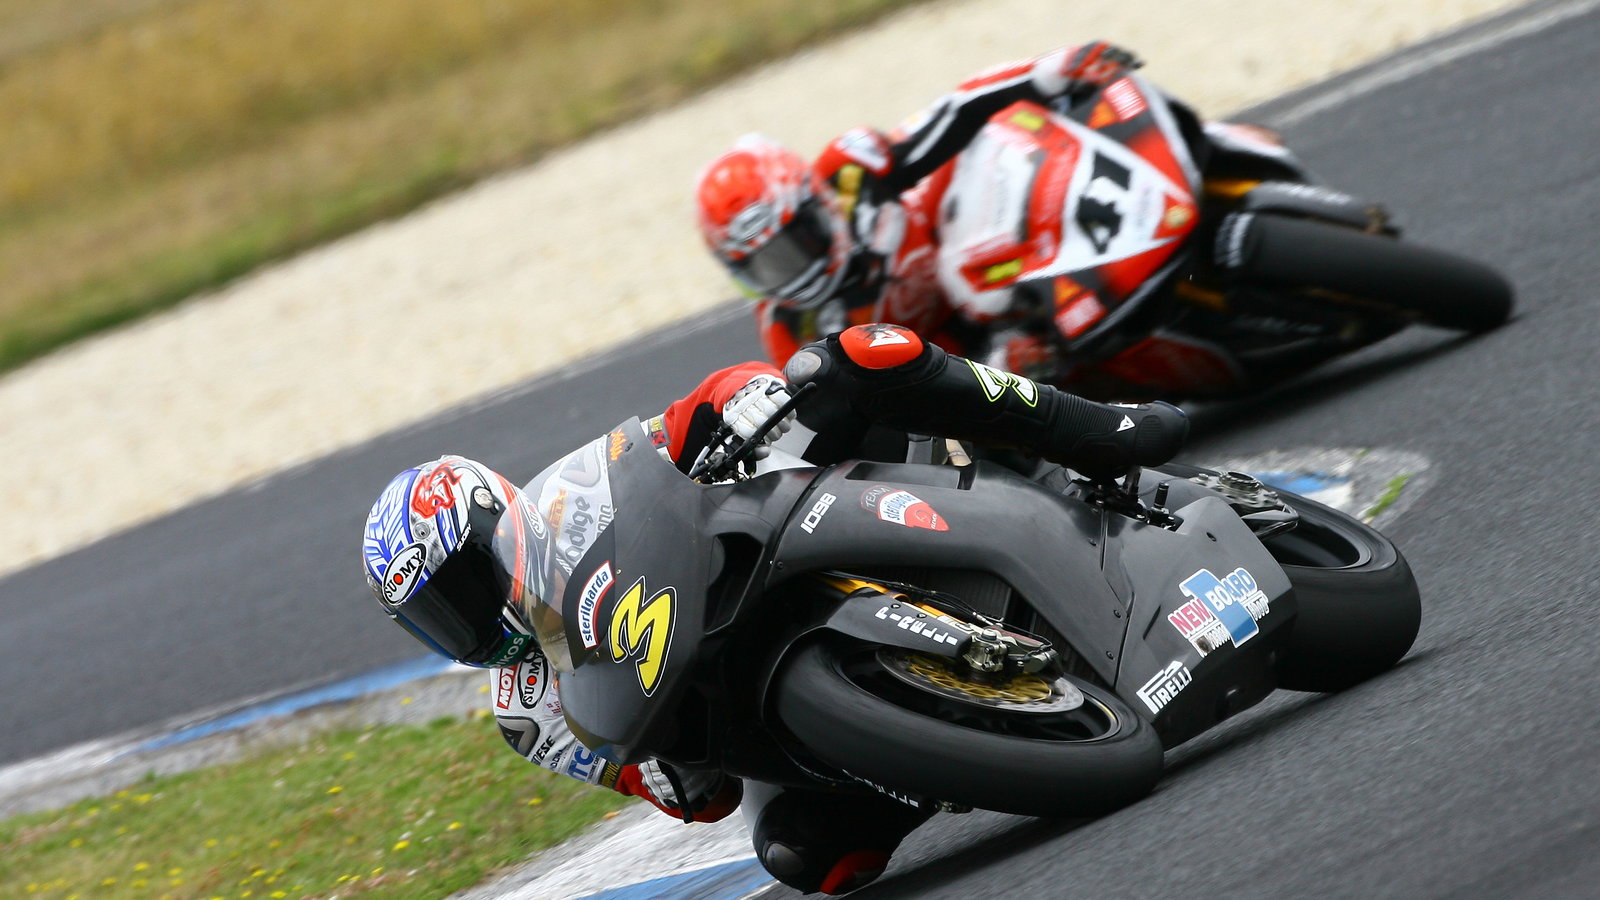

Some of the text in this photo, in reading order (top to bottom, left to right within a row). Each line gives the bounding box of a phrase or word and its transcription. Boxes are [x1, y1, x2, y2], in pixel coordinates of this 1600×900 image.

[1076, 152, 1132, 255] 41
[800, 492, 837, 535] 1098
[865, 487, 891, 508] TEAM
[384, 550, 425, 598] SUOMY
[1204, 568, 1257, 613] BOARD
[583, 570, 609, 643] sterilgarda
[874, 606, 958, 646] PIRELLI
[1168, 597, 1213, 636] NEW
[609, 578, 676, 695] 3
[1136, 660, 1193, 714] PIRELLI
